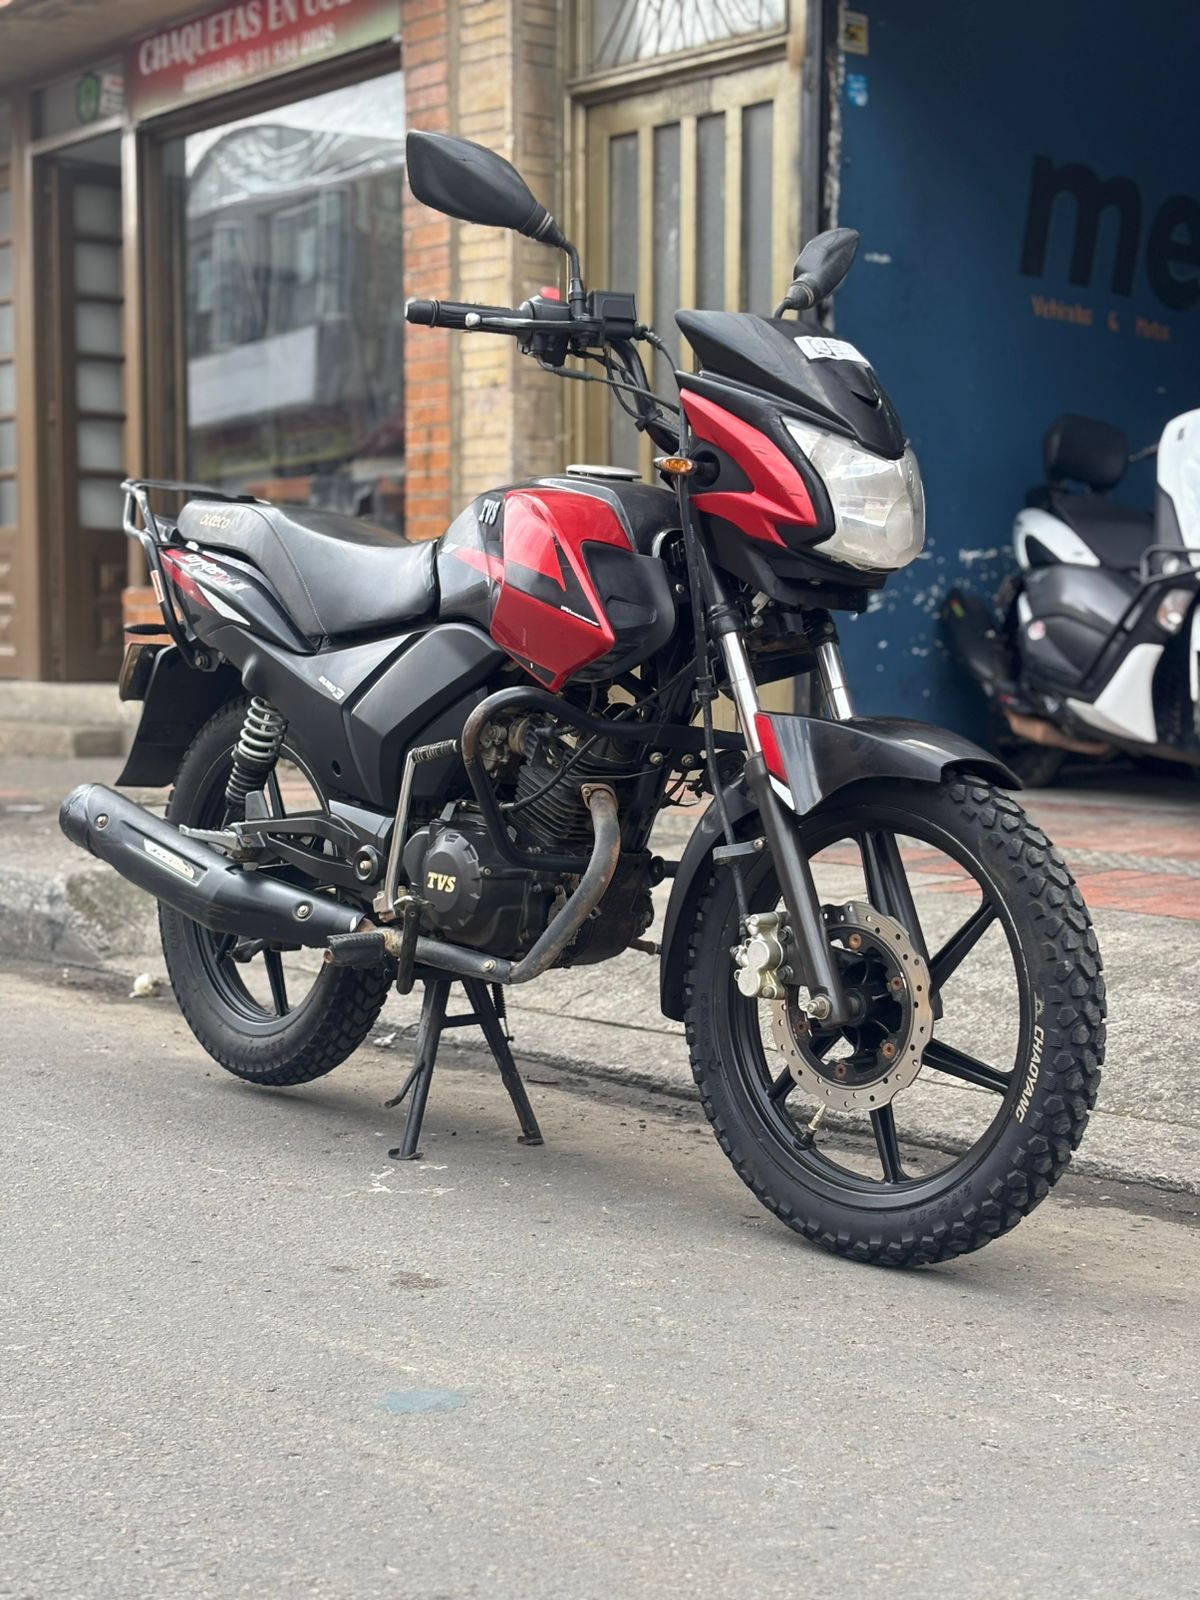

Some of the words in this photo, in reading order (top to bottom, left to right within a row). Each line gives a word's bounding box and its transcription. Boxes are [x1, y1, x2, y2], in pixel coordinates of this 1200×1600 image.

[138, 1, 263, 76] CHAQUETAS
[478, 498, 501, 525] TVS
[426, 871, 457, 894] TVS
[1015, 1024, 1045, 1124] CHAOYANG
